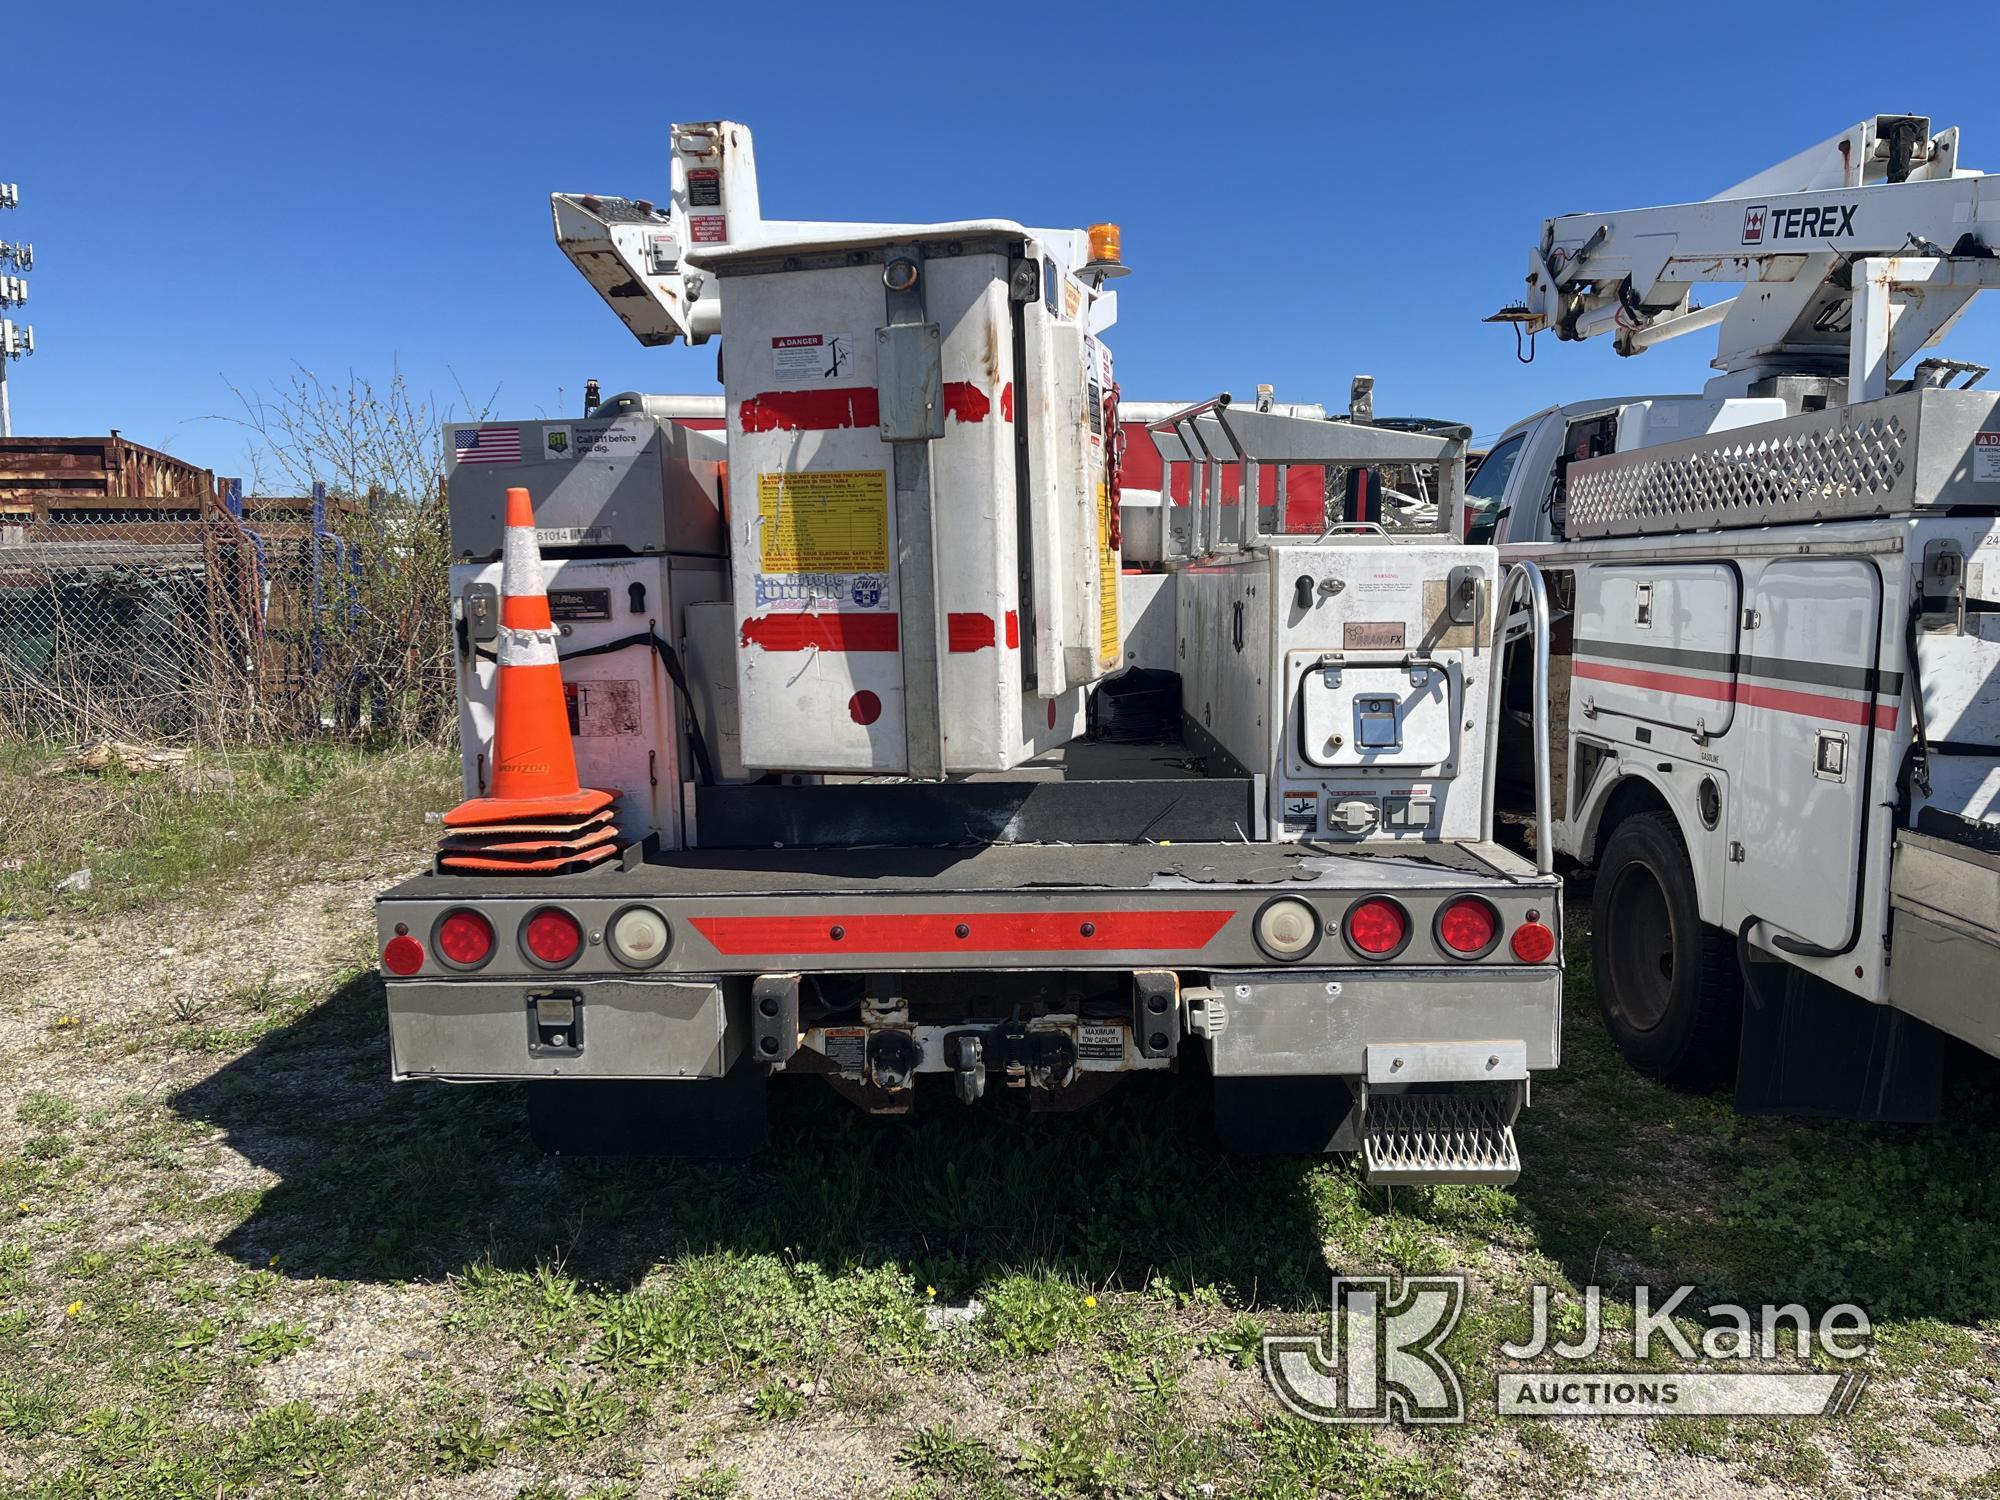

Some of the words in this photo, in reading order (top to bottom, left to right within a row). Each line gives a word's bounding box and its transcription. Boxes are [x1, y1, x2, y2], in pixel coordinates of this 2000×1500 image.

[1771, 204, 1859, 239] TEREX
[786, 338, 818, 346] DANGER
[550, 433, 566, 445] 811
[576, 435, 593, 444] Call
[608, 434, 637, 442] before
[576, 446, 593, 454] you
[856, 580, 876, 590] CWA
[764, 586, 844, 599] UNION
[1702, 752, 1720, 764] GASOLINE
